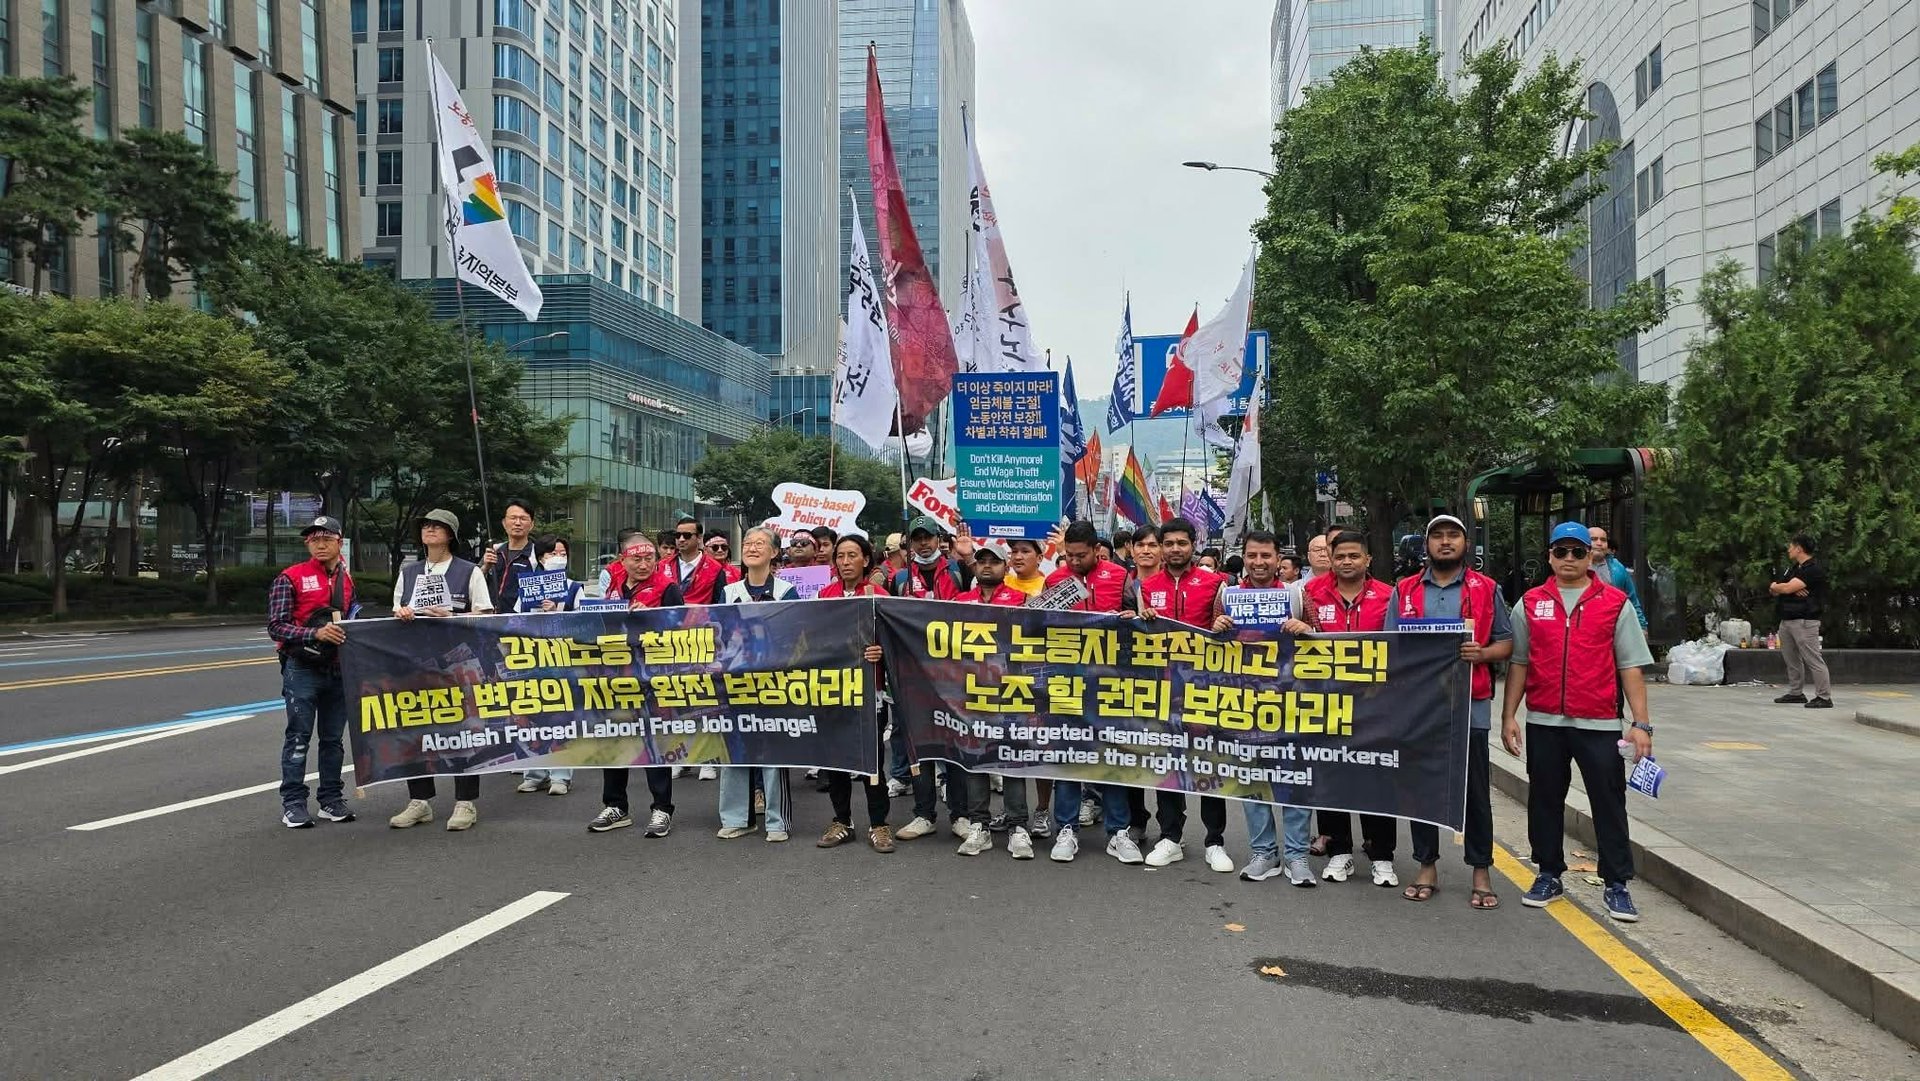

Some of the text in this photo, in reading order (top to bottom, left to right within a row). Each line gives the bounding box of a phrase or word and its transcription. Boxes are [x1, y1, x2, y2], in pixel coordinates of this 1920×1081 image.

[957, 380, 1053, 395] 더 이상 죽이지 마라!
[969, 395, 1041, 410] 임금체불 근절!
[970, 411, 1012, 425] 노동안전
[965, 425, 1047, 439] 차별과 착취 철폐!
[970, 454, 1043, 465] Don't Kill Anymore!
[974, 466, 1039, 478] End Wage Theft!
[960, 478, 986, 488] Ensure
[986, 479, 1023, 489] Worklace
[783, 491, 856, 513] Rights-based
[962, 490, 1053, 502] Eliminate Discrimination
[976, 503, 1039, 514] and Exploitation!
[792, 510, 843, 528] Policy of
[523, 581, 565, 597] 자유 보장!
[1227, 592, 1288, 604] 사업장 변경의
[1230, 602, 1286, 617] 자유 보장!
[1245, 617, 1257, 625] Job
[499, 627, 715, 670] 강제노동 철폐!
[926, 620, 1388, 682] 이주 노동자 표적해고 중단!
[361, 668, 863, 733] 사업장 변경의 자유 완전 보장하라!
[965, 673, 1354, 736] 노조 할 권리 보장하라!
[421, 713, 818, 752] Abolish Forced Labor! Free Job Change!
[933, 710, 1400, 768] Stop the targeted dismissal of migrant workers!
[998, 745, 1313, 786] Guarantee the right to organize!
